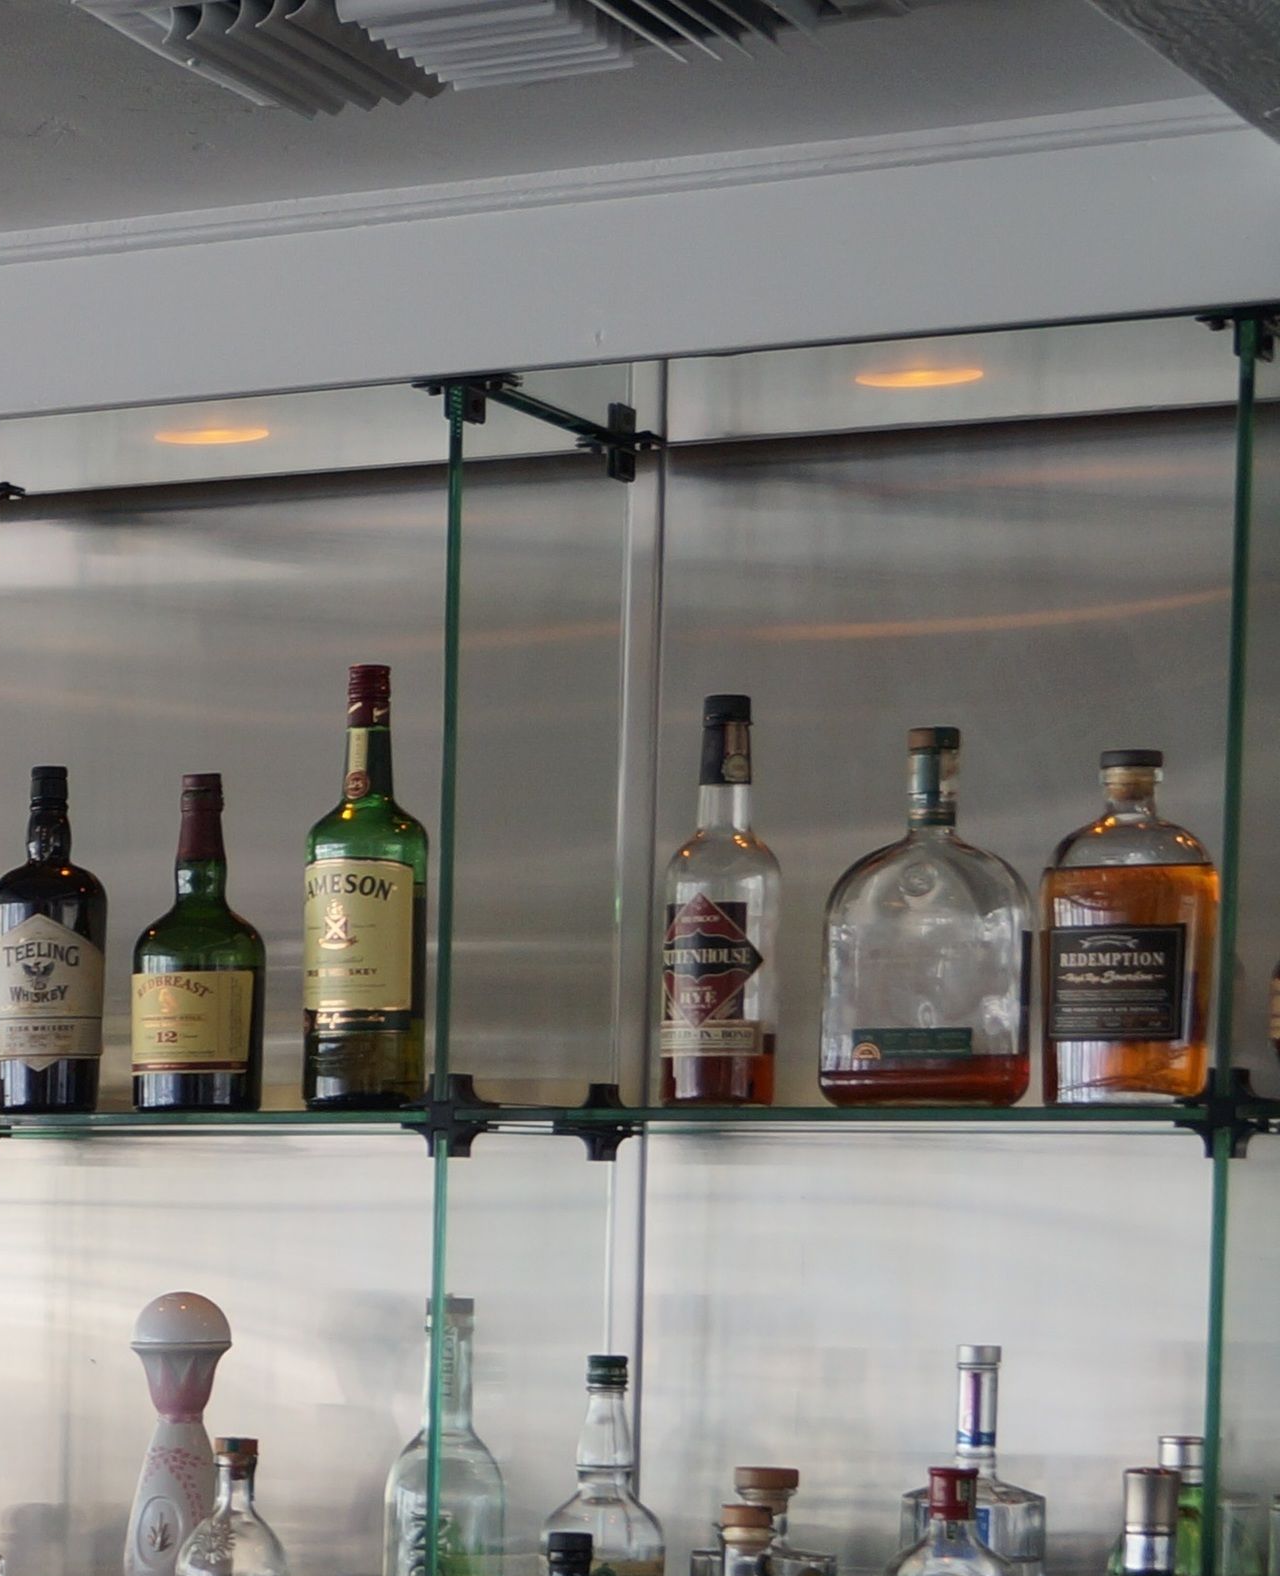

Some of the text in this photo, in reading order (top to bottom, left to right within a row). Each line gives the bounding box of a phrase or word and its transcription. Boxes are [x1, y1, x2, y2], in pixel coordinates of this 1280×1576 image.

[306, 873, 393, 901] AMESON
[2, 942, 80, 968] TEELING
[1059, 951, 1166, 968] REDEMPTION
[136, 975, 209, 998] REDBREAST
[679, 991, 718, 1005] RYE
[156, 1030, 178, 1044] 12
